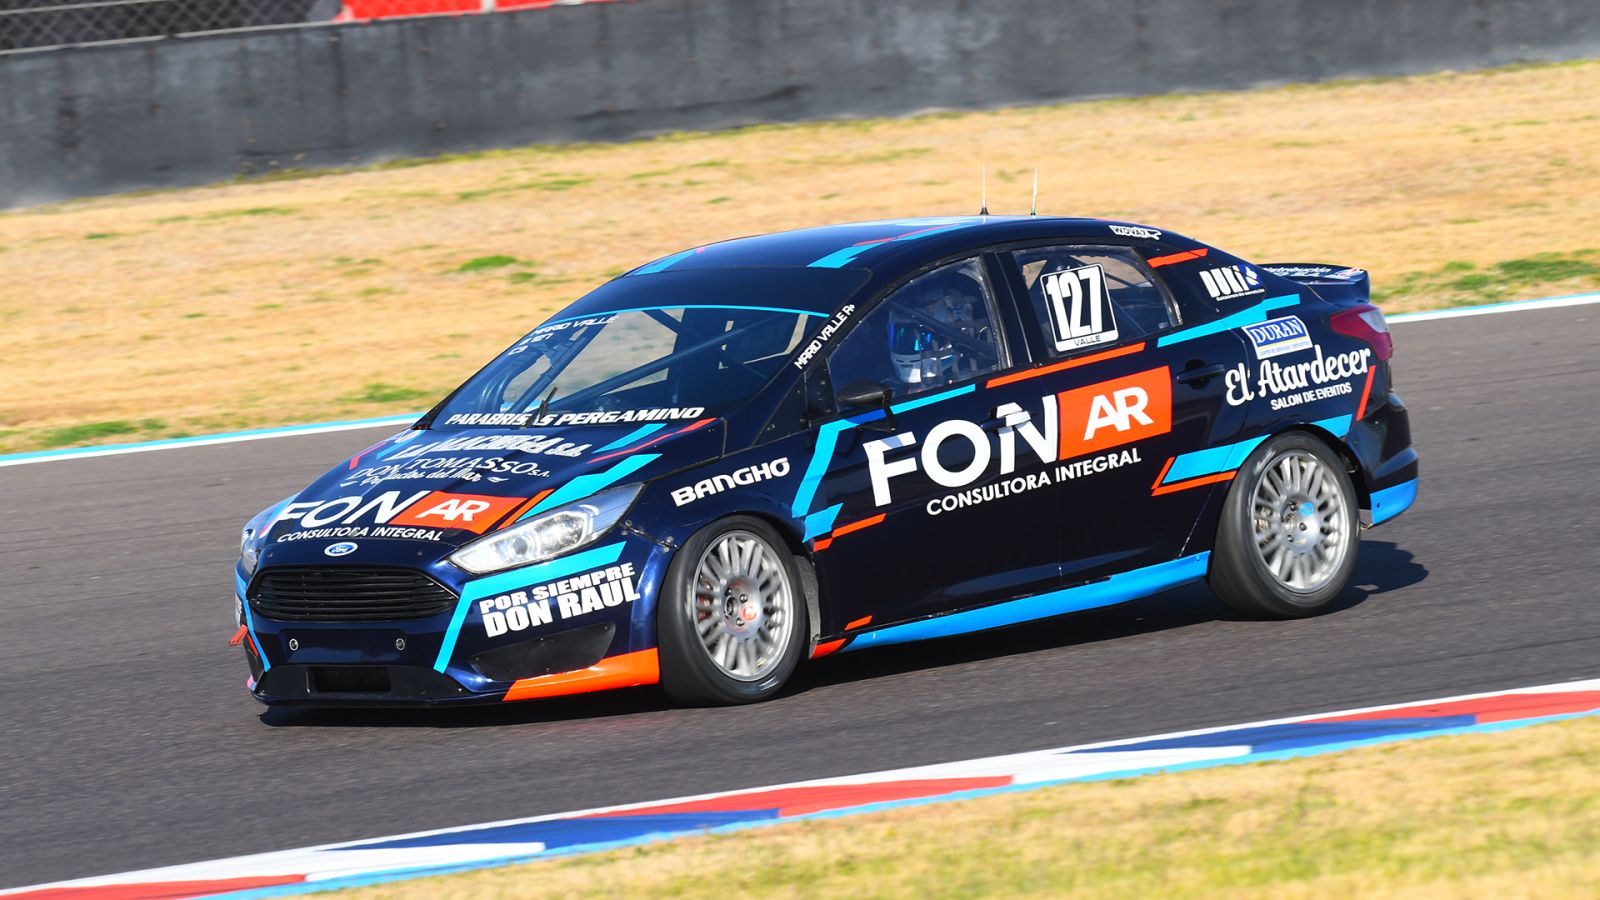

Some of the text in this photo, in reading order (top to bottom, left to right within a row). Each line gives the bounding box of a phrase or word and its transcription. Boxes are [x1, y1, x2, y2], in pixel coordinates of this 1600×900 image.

[1046, 266, 1102, 340] 127
[573, 315, 619, 328] VALLE
[1249, 320, 1303, 343] DURAN
[794, 340, 822, 369] MARIO
[817, 312, 847, 341] VALLE
[1073, 335, 1101, 346] VALLE
[1226, 344, 1371, 406] El Atardecer
[1271, 382, 1352, 410] SALON DE EVENTOS
[444, 407, 705, 427] PARABRISS PERGAMINO
[346, 464, 402, 481] DON
[407, 457, 539, 475] TOMASSO
[926, 448, 1142, 515] CONSULTORA INTEGRAL
[277, 525, 445, 544] CONSULTORA INTEGRAL
[479, 562, 636, 615] POR SIEMPRE
[481, 578, 641, 638] DON RAUL
